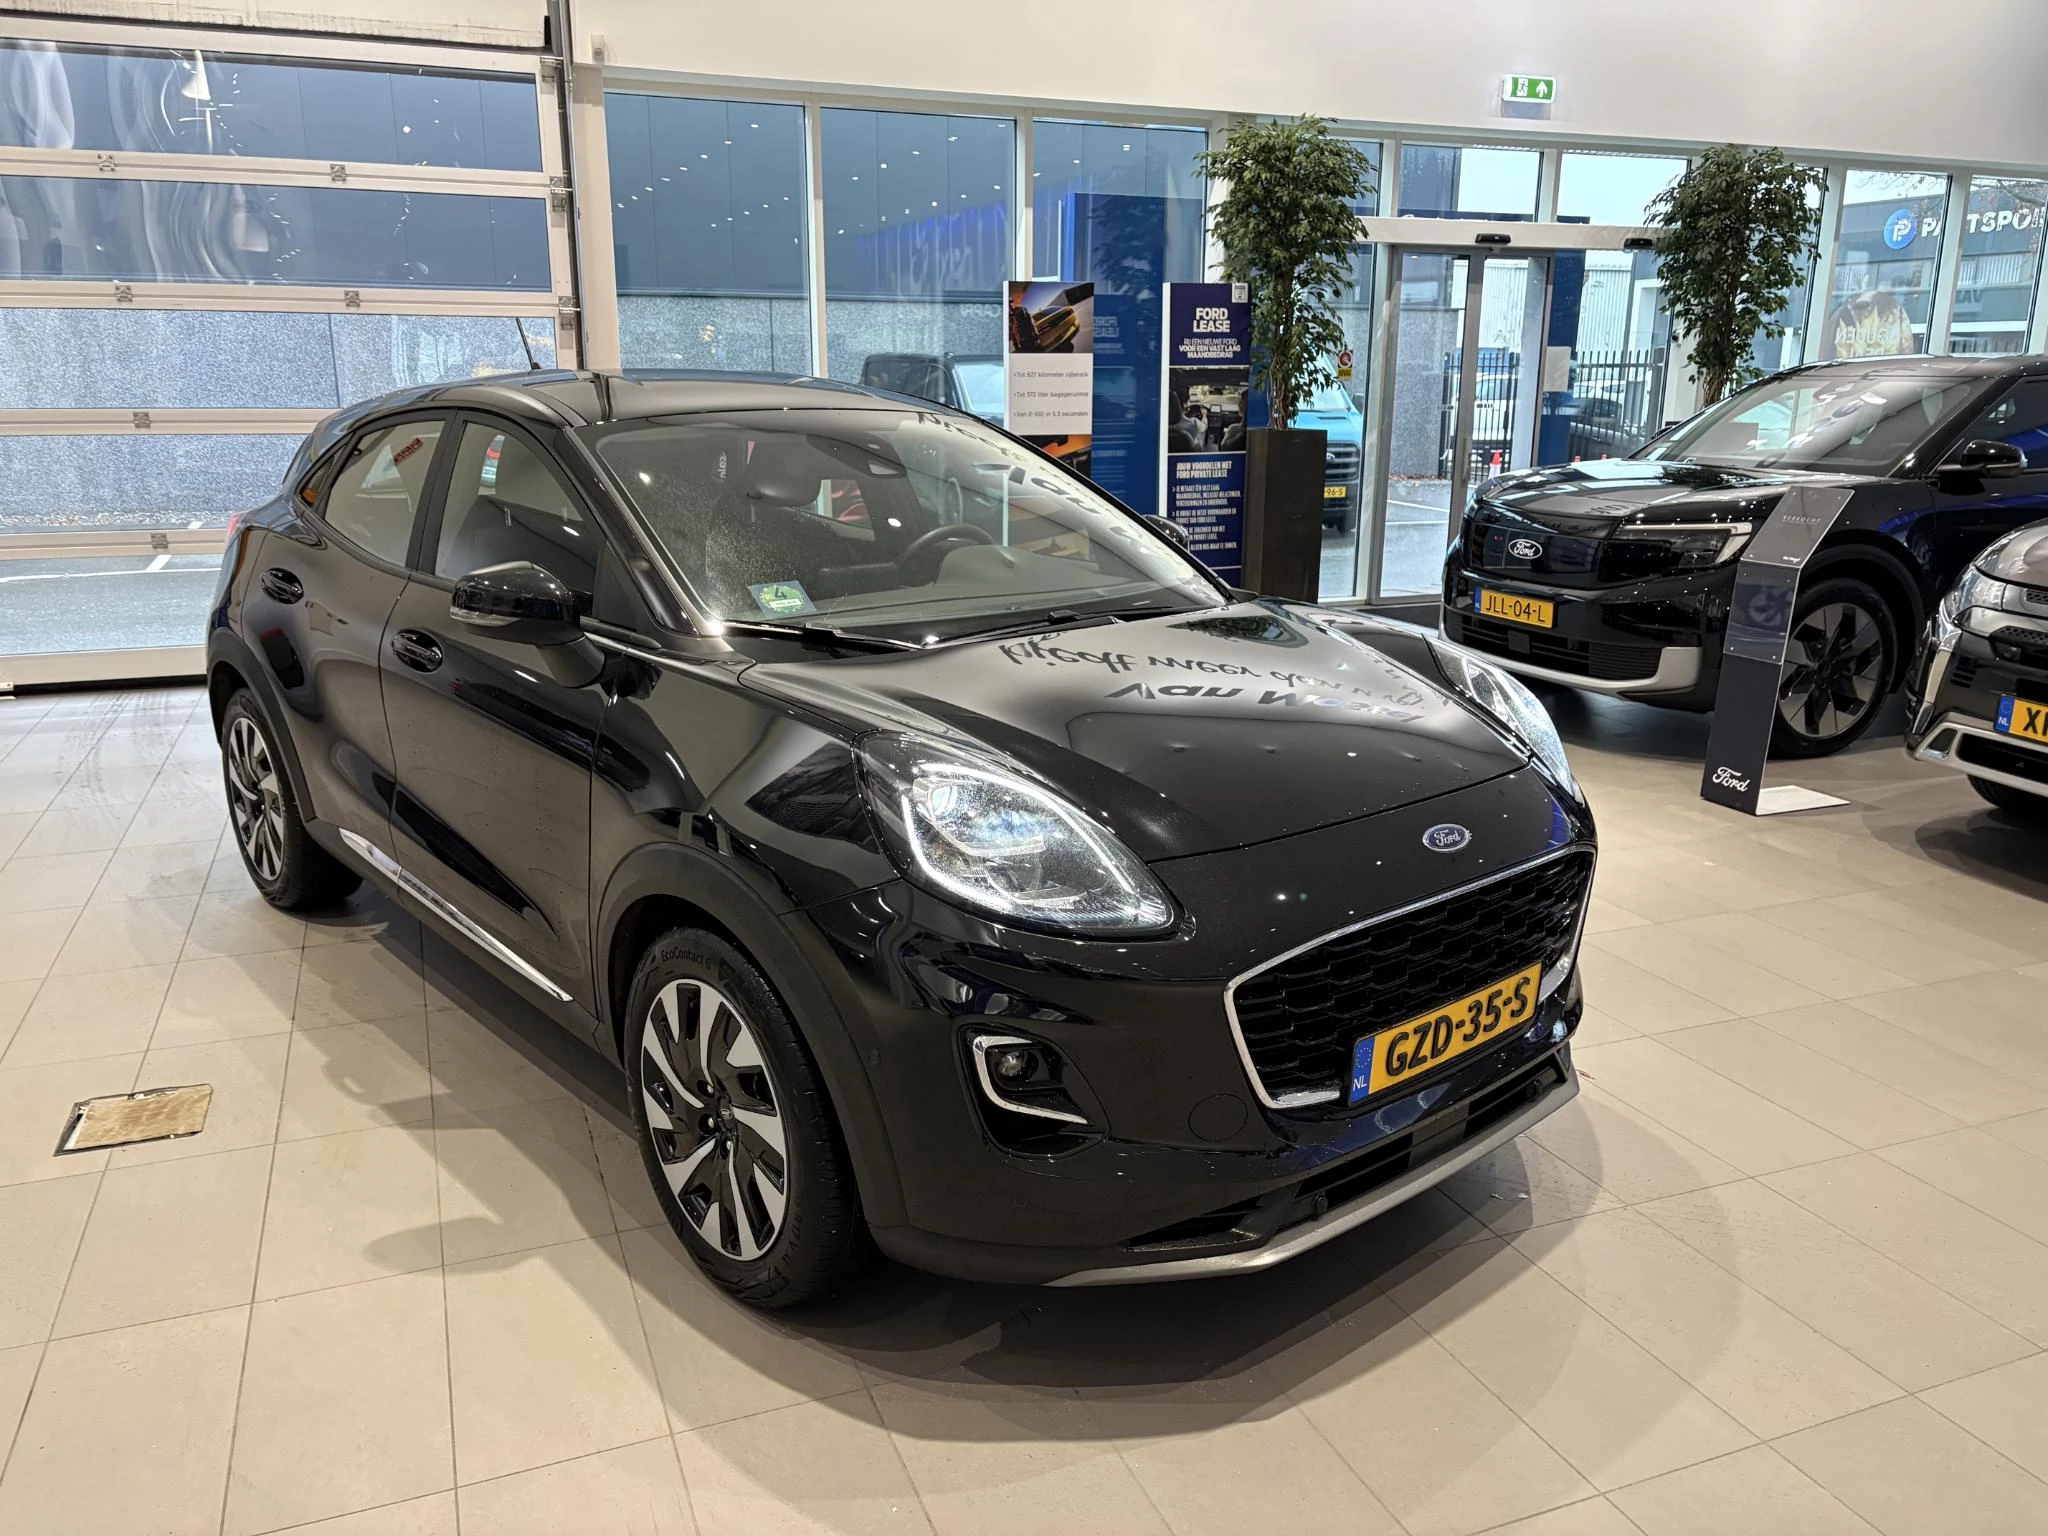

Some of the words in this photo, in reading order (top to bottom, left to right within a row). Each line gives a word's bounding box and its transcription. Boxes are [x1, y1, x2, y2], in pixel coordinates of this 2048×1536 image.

[1195, 307, 1228, 320] FORD
[1193, 320, 1230, 333] LEASE
[1187, 351, 1233, 359] MAANDBEDRAG
[1191, 470, 1212, 478] PRIVATE
[1212, 469, 1228, 478] LEASE
[774, 587, 788, 599] 4
[1485, 594, 1546, 623] JLL-04-L
[1998, 716, 2009, 726] NL
[2023, 707, 2048, 736] X
[1712, 766, 1751, 792] Ford
[661, 946, 704, 965] EcoContact
[1351, 1074, 1368, 1091] NL
[1385, 975, 1532, 1078] GZD-35-S
